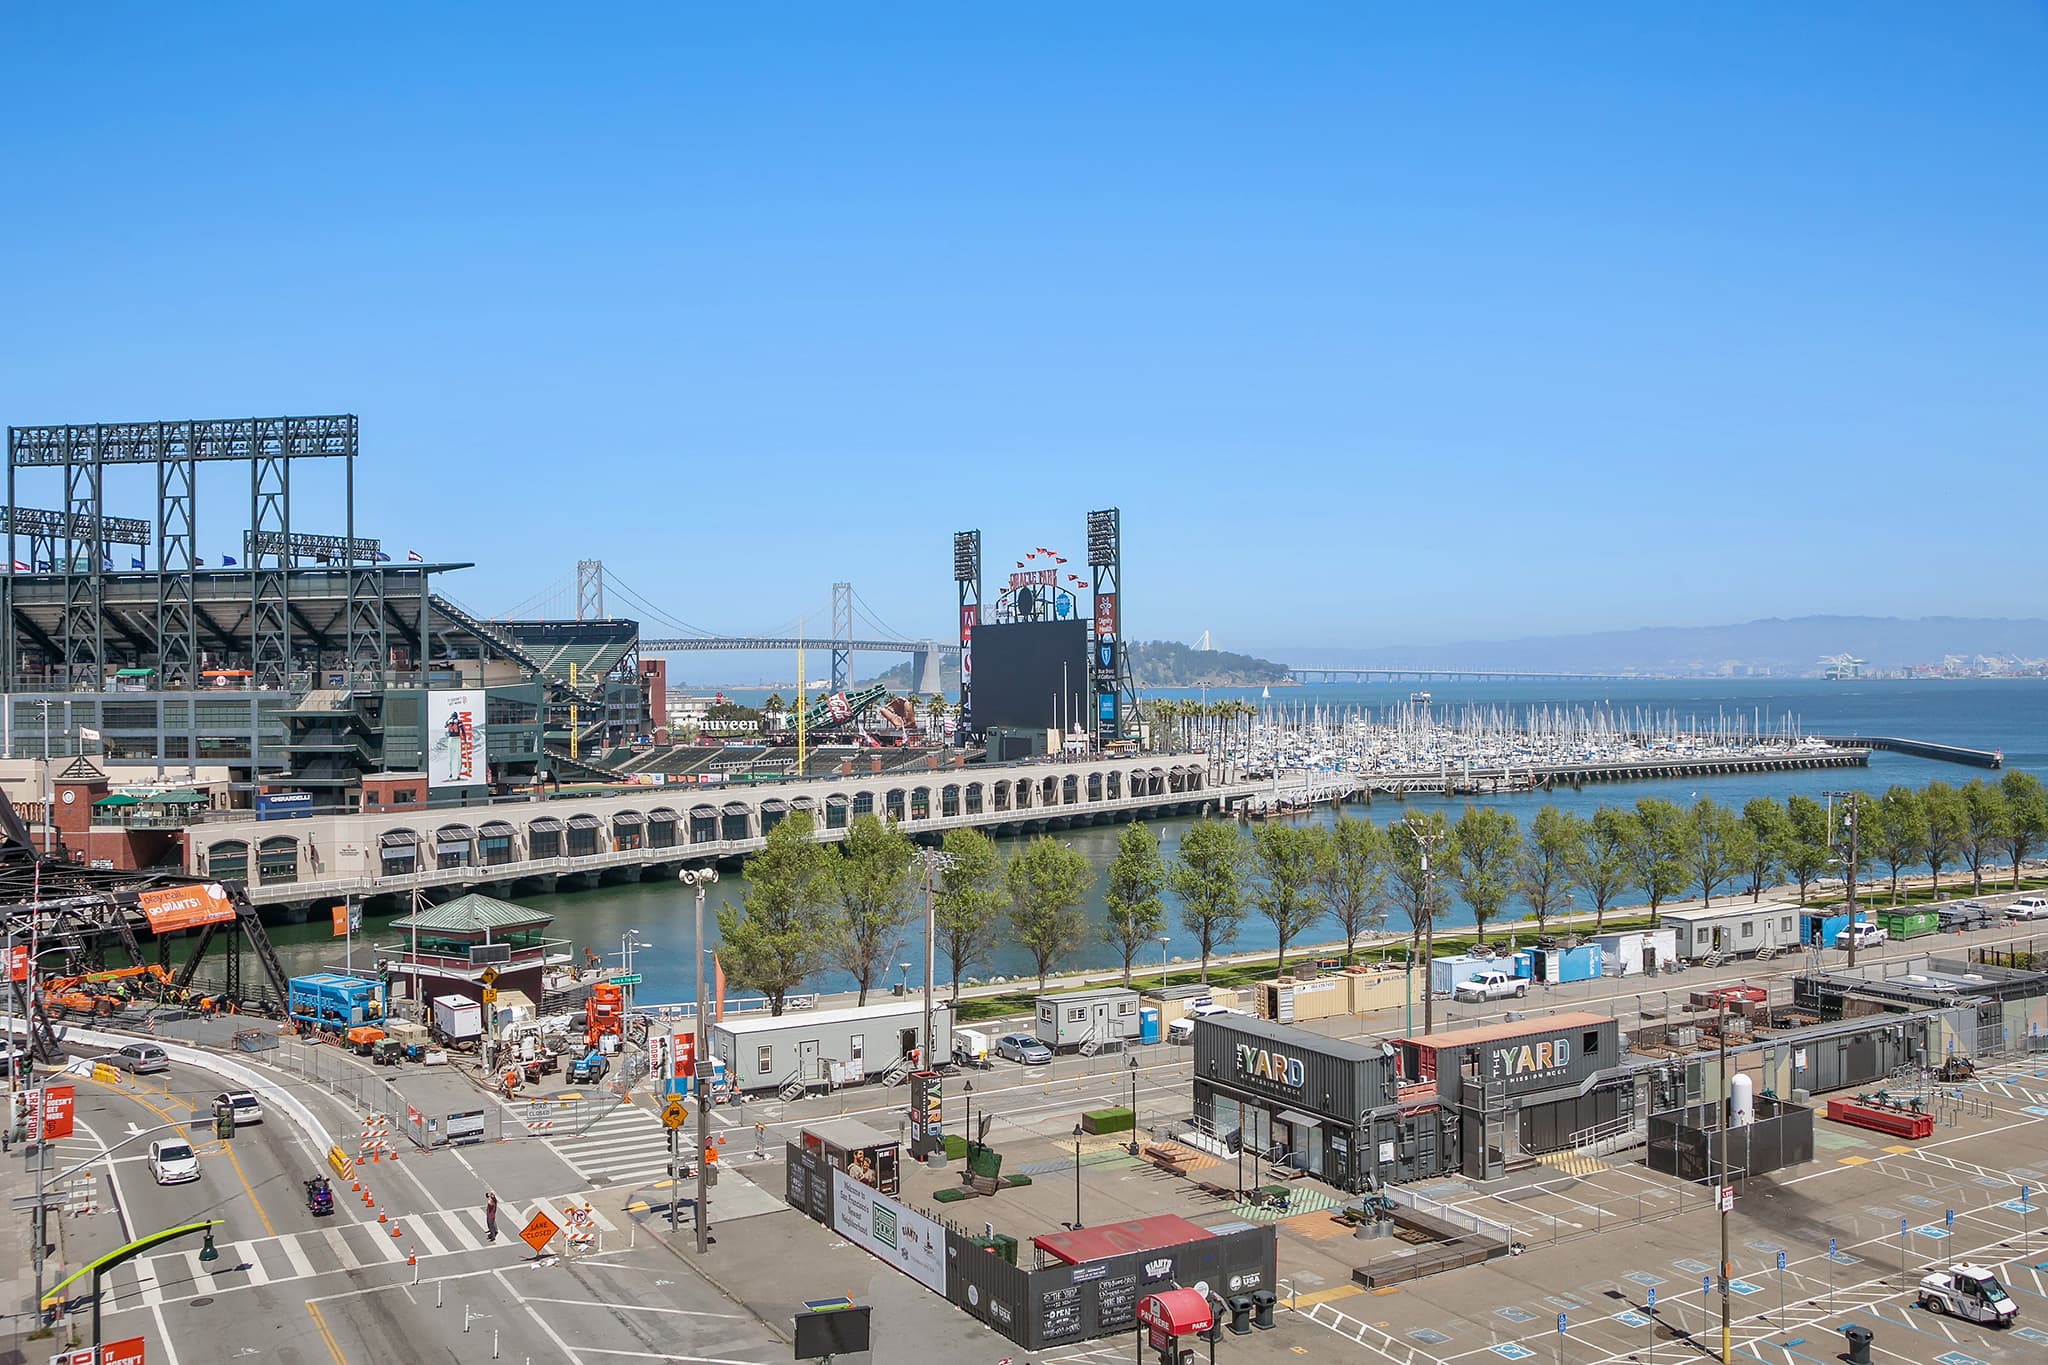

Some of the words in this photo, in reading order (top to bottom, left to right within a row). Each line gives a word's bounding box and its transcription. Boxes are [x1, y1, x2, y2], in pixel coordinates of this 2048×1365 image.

[699, 719, 759, 731] nuveen
[148, 907, 162, 916] go
[485, 990, 494, 998] 15
[1500, 1039, 1570, 1076] YARD
[1240, 1043, 1305, 1088] YARD
[1510, 1073, 1543, 1084] MISSION
[1546, 1068, 1567, 1077] ROCK
[1251, 1076, 1279, 1090] MISSION
[47, 1098, 73, 1106] DOESN'T
[927, 1083, 942, 1136] YARD
[28, 1092, 39, 1139] CRAWFORD
[46, 1112, 64, 1120] MORE
[531, 1221, 548, 1231] LANE
[526, 1230, 552, 1239] CLOSED
[901, 1225, 919, 1243] GIANTS
[1145, 1259, 1172, 1274] GIANTS
[1242, 1275, 1261, 1286] USA
[1049, 1308, 1071, 1319] OPEN
[1141, 1309, 1152, 1321] PAY
[1153, 1316, 1169, 1330] HERE
[1192, 1321, 1208, 1330] PARK
[105, 1351, 114, 1362] IT
